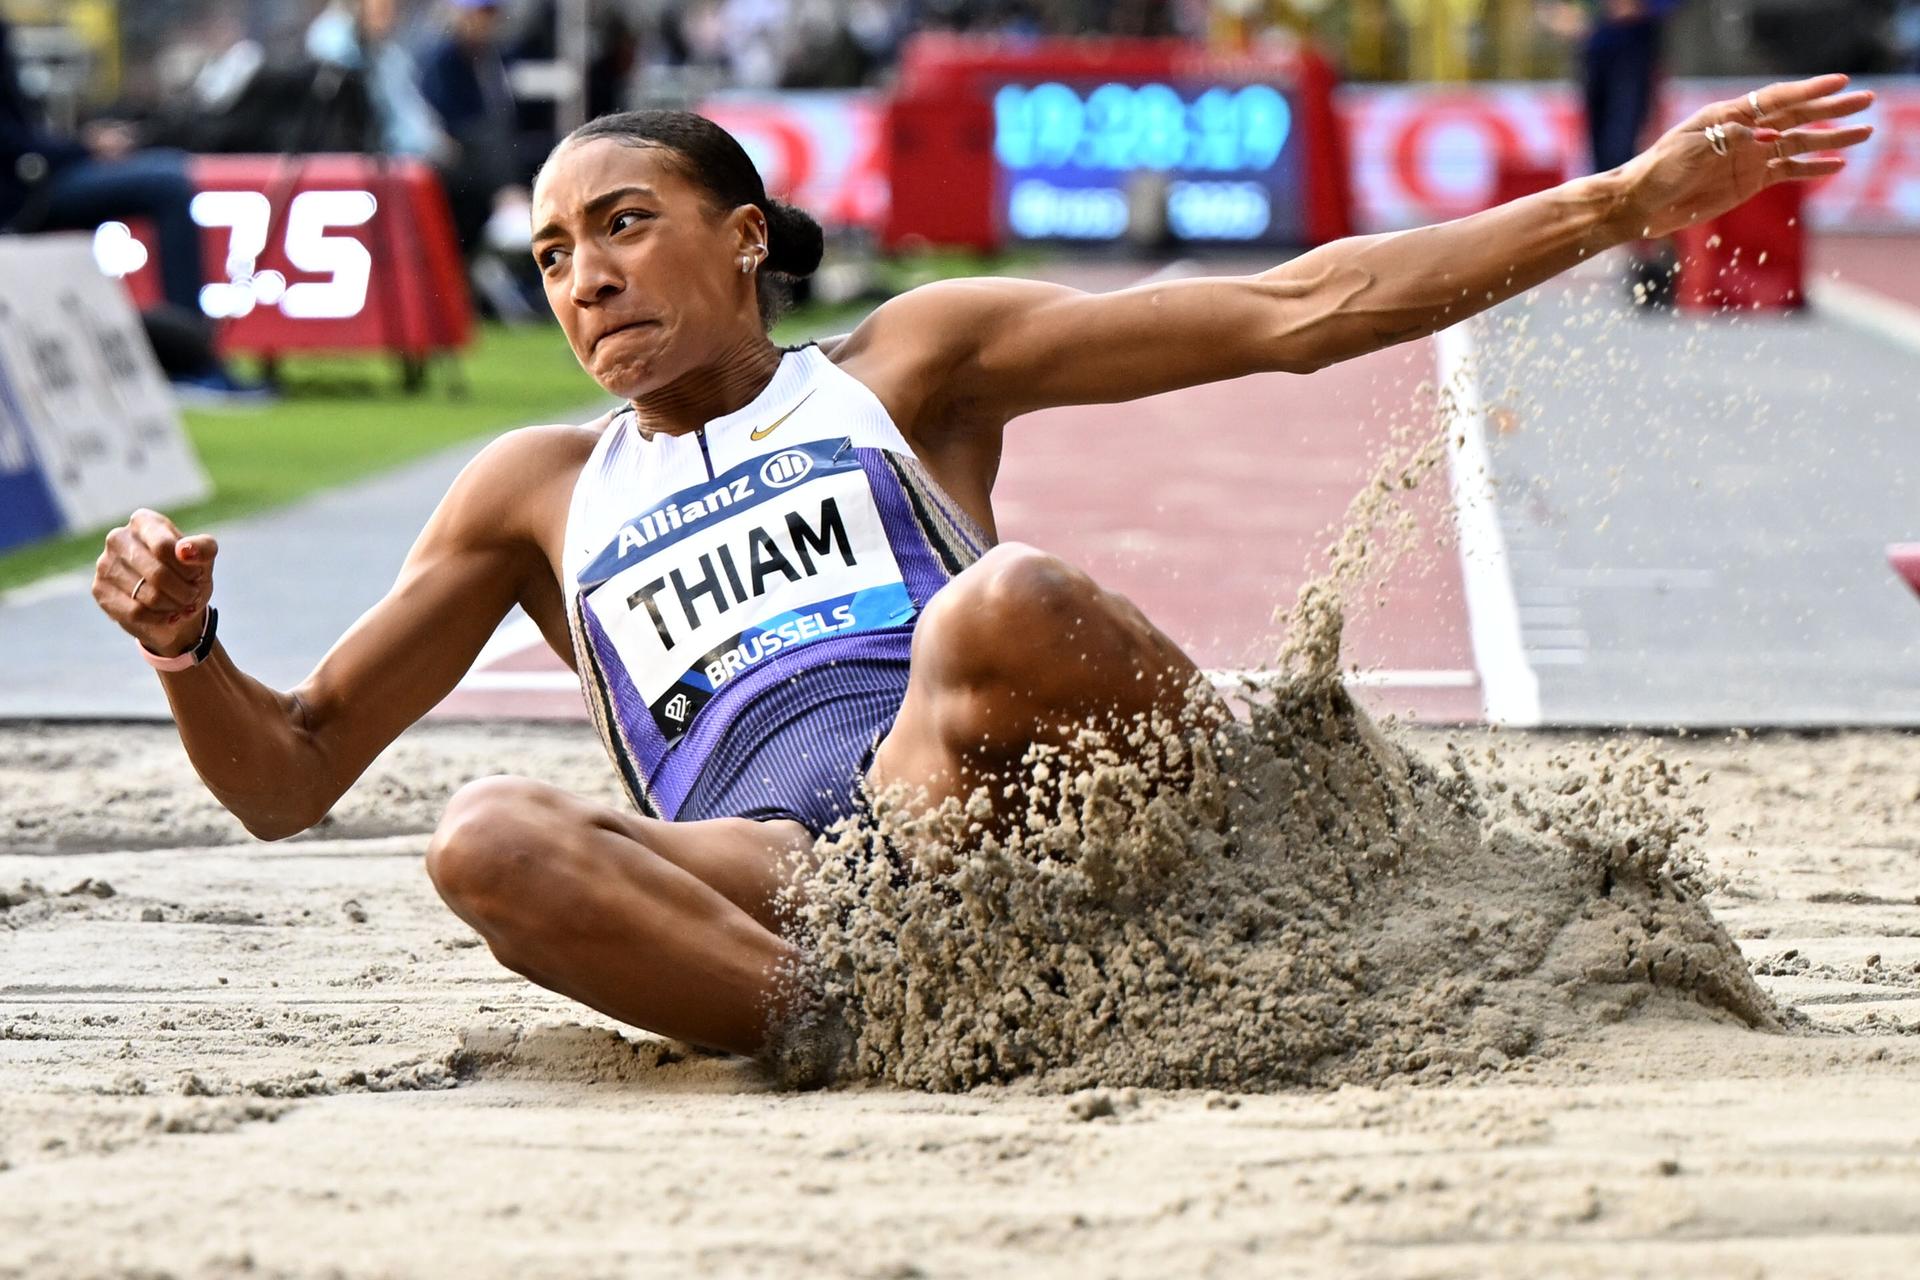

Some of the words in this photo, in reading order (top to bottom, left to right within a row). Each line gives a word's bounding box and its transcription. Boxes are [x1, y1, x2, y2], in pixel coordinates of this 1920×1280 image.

[616, 474, 755, 559] Allianz
[626, 496, 858, 651] THIAM
[704, 603, 856, 689] BRUSSELS
